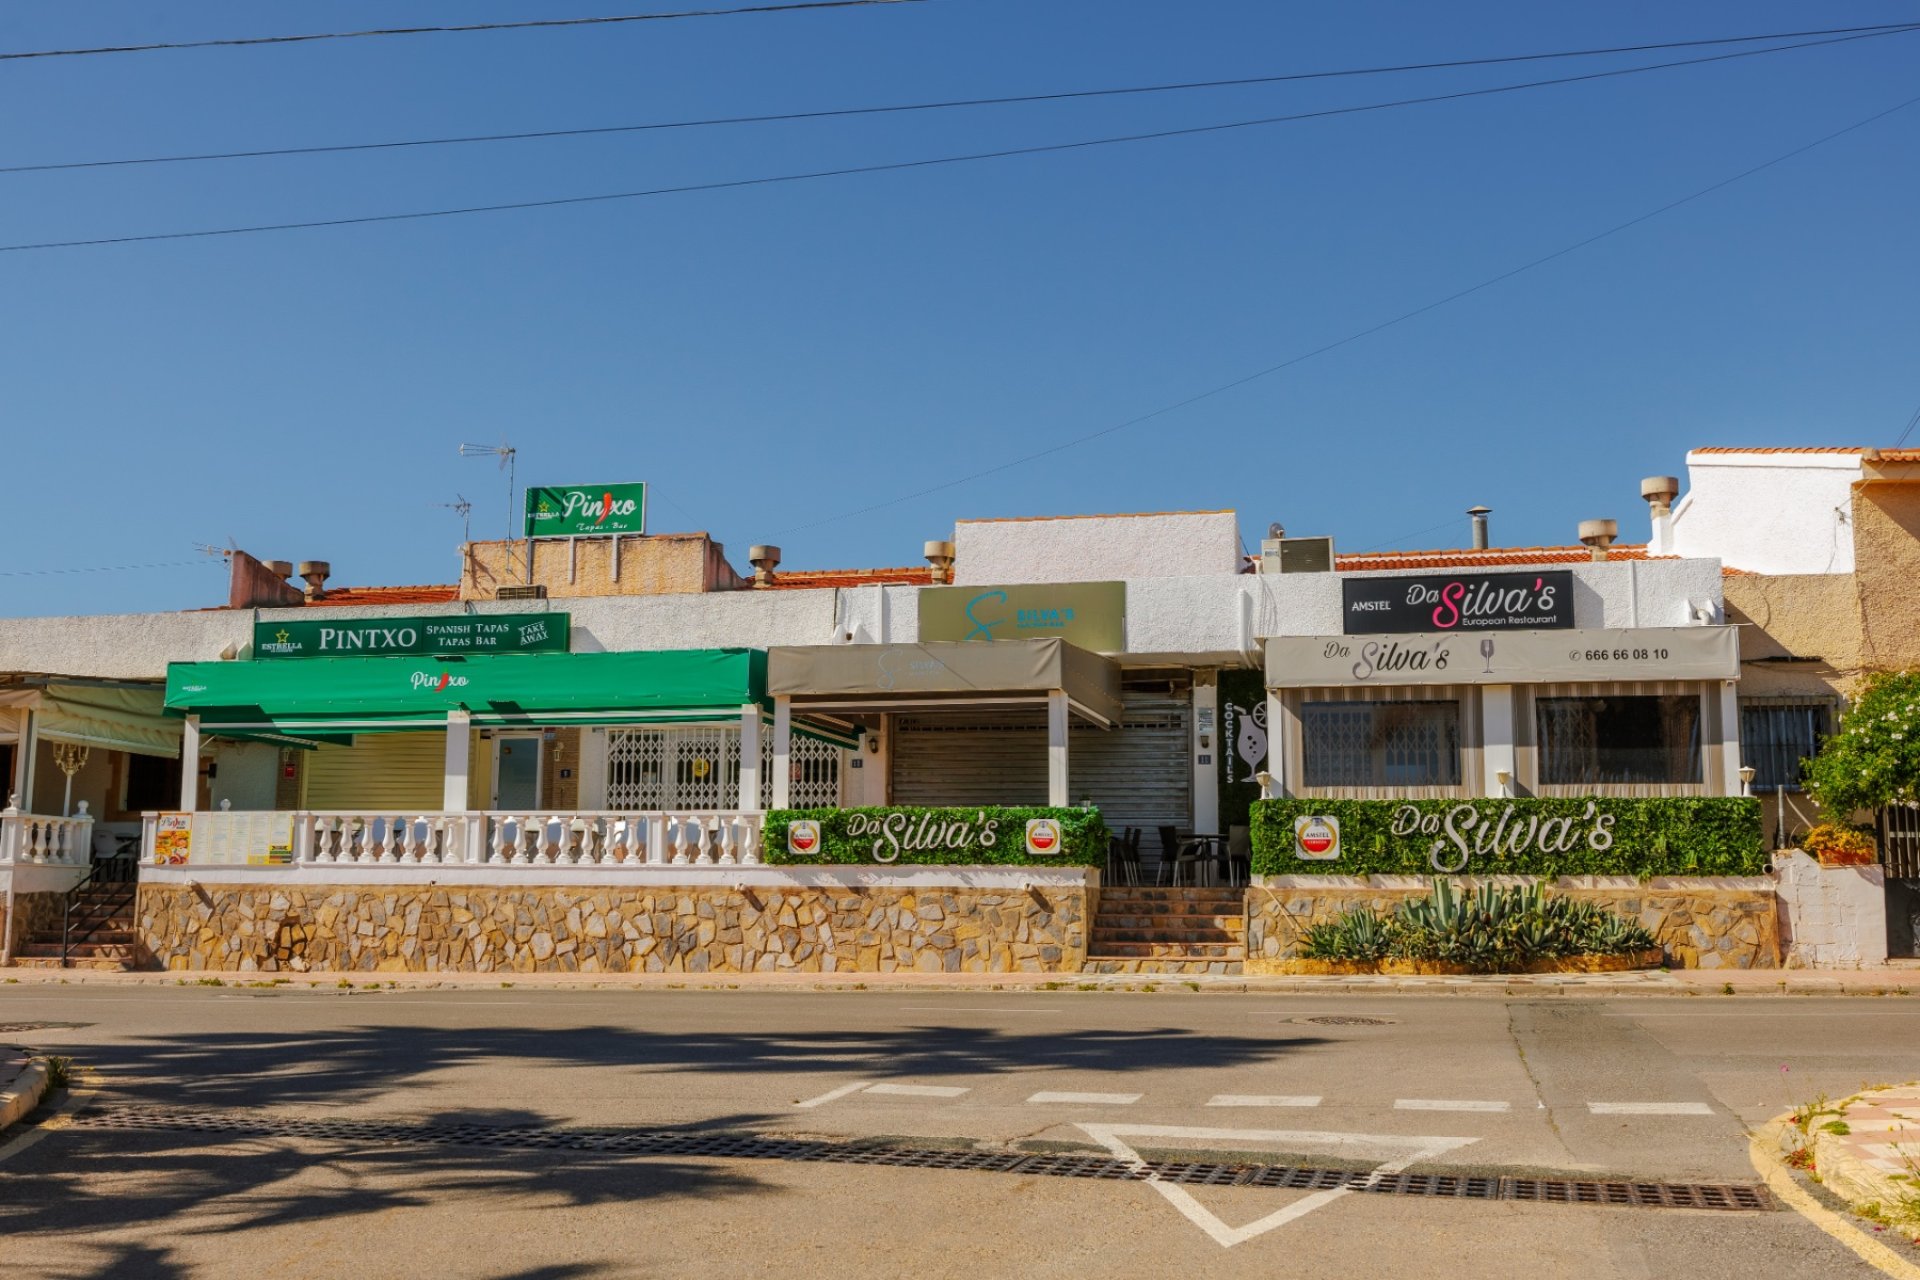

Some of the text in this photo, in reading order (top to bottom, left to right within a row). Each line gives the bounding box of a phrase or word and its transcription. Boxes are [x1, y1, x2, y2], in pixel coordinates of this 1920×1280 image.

[1352, 601, 1391, 612] AMSTEL
[1406, 577, 1556, 627] Da Silva's
[1462, 614, 1557, 626] European Restaurant
[426, 623, 510, 635] SPANISH TAPAS
[519, 622, 545, 636] TAKE
[318, 628, 417, 650] PINTXO
[438, 636, 497, 646] TAPAS BAR
[261, 642, 303, 651] ESTRELLA
[1323, 641, 1450, 680] Da Silva's
[1585, 648, 1669, 661] 666 66 08 10
[1224, 702, 1235, 784] COCKTAILS
[847, 811, 999, 862] Da Silva's
[1391, 801, 1616, 872] Da Silva's
